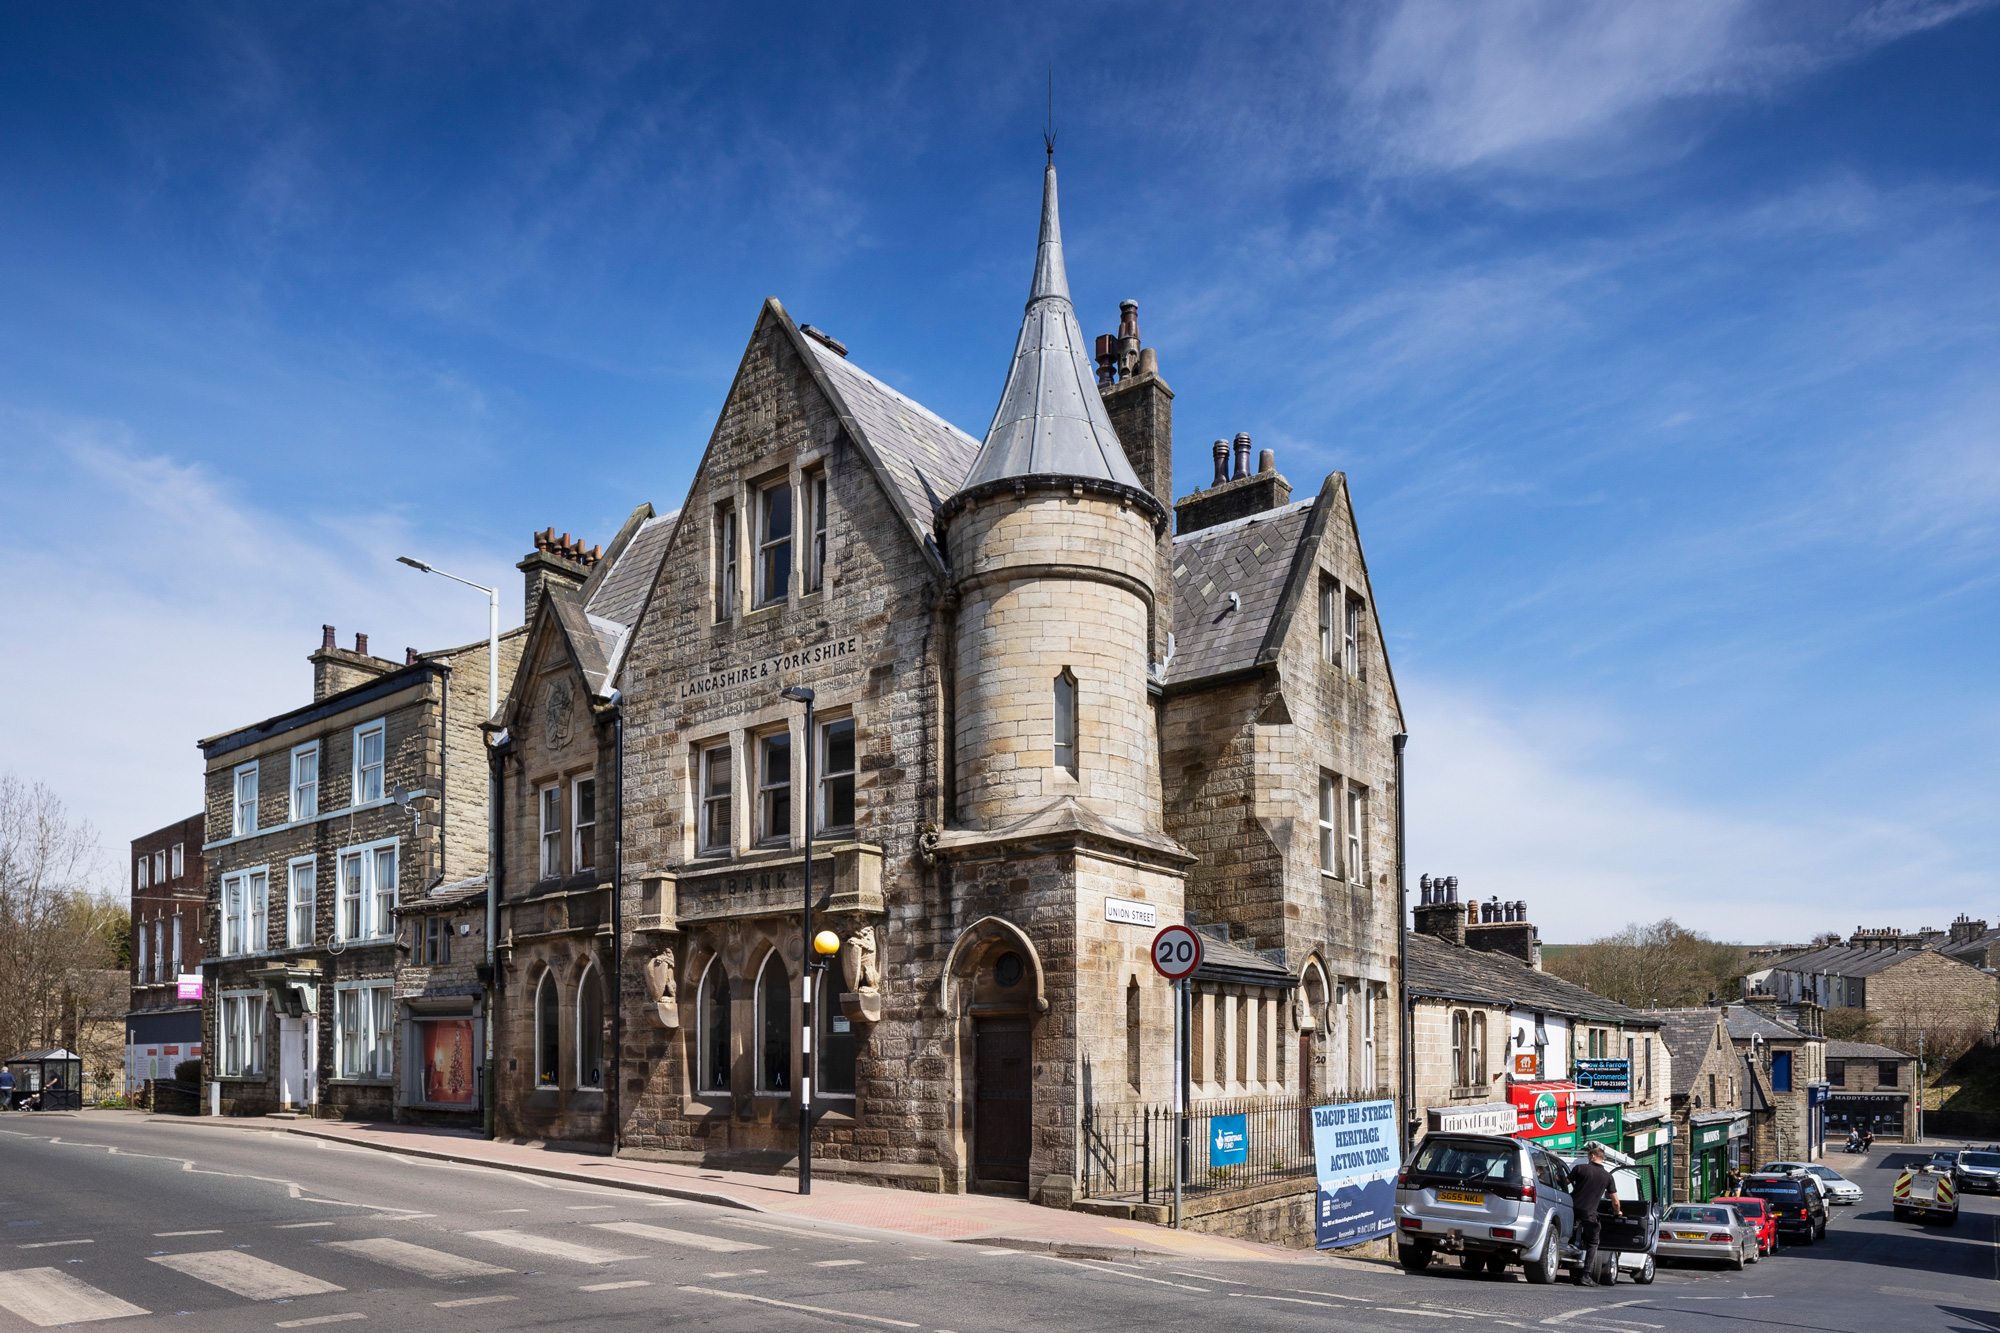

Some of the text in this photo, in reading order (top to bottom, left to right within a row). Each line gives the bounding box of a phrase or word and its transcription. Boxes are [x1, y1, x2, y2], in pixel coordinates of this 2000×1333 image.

[681, 638, 856, 698] LANCASHIRE & YORKSHIRE
[727, 872, 788, 896] BANK
[1107, 907, 1154, 922] UNION STREET
[1158, 940, 1193, 963] 20
[1315, 1055, 1327, 1064] 20
[1315, 1104, 1392, 1127] BACUP Hi! STREET
[1224, 1134, 1243, 1142] HERITAGE
[1335, 1127, 1379, 1148] HERITAGE
[1331, 1147, 1389, 1171] ACTION ZONE
[1441, 1192, 1480, 1203] SG55 NKL
